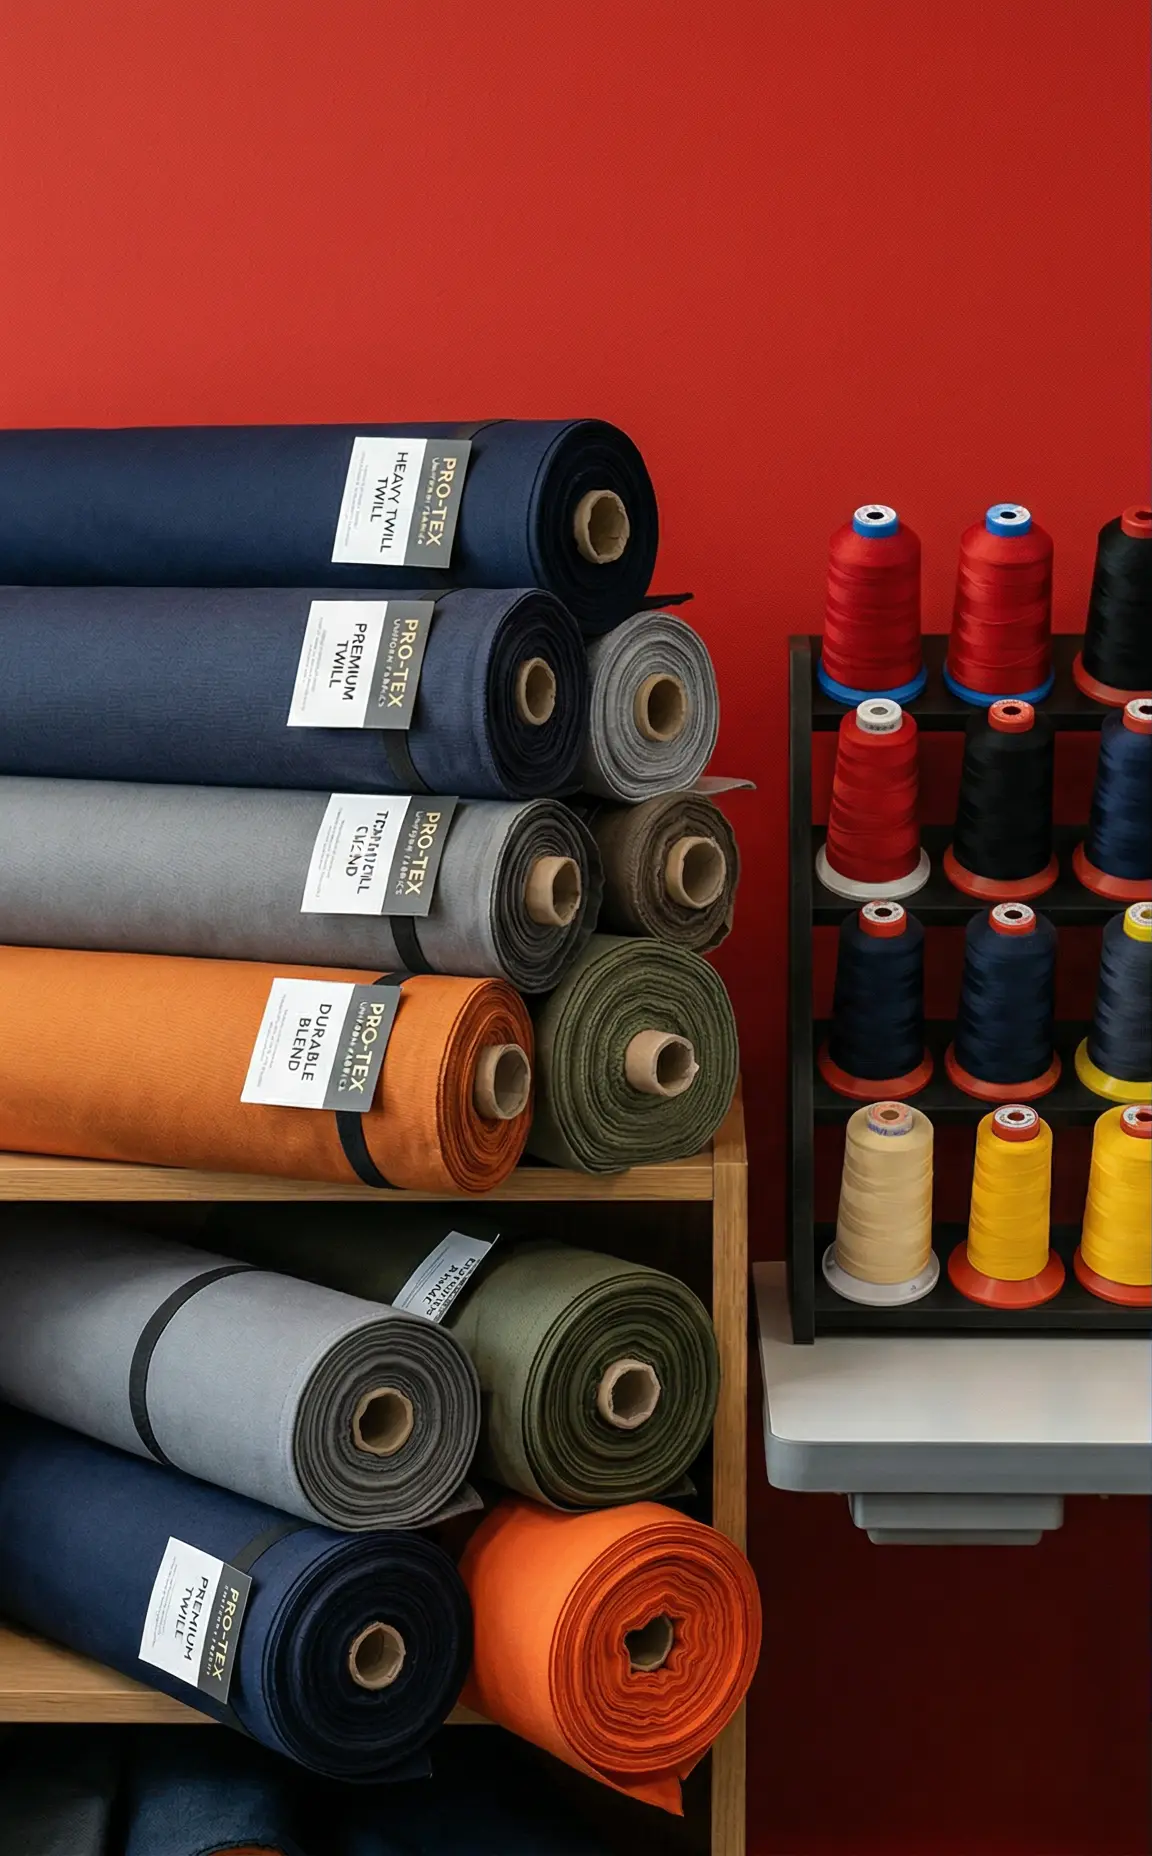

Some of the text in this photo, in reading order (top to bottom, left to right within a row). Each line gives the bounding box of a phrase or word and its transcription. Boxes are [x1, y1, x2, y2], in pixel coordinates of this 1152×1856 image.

[370, 476, 389, 522] TWILL
[380, 451, 409, 553] HEAVY TWILL
[426, 457, 457, 546] PRO-TEX
[329, 640, 349, 689] TWILL
[342, 623, 368, 701] PREMIUM
[387, 618, 419, 708] PRO-TEX
[405, 811, 441, 895] PRO-TEX
[288, 1017, 312, 1072] BLEND
[301, 1003, 332, 1082] DURABLE
[349, 1002, 385, 1094] PRO-TEX
[184, 1576, 209, 1661] PREMIUM
[212, 1587, 239, 1682] PRO-TEX
